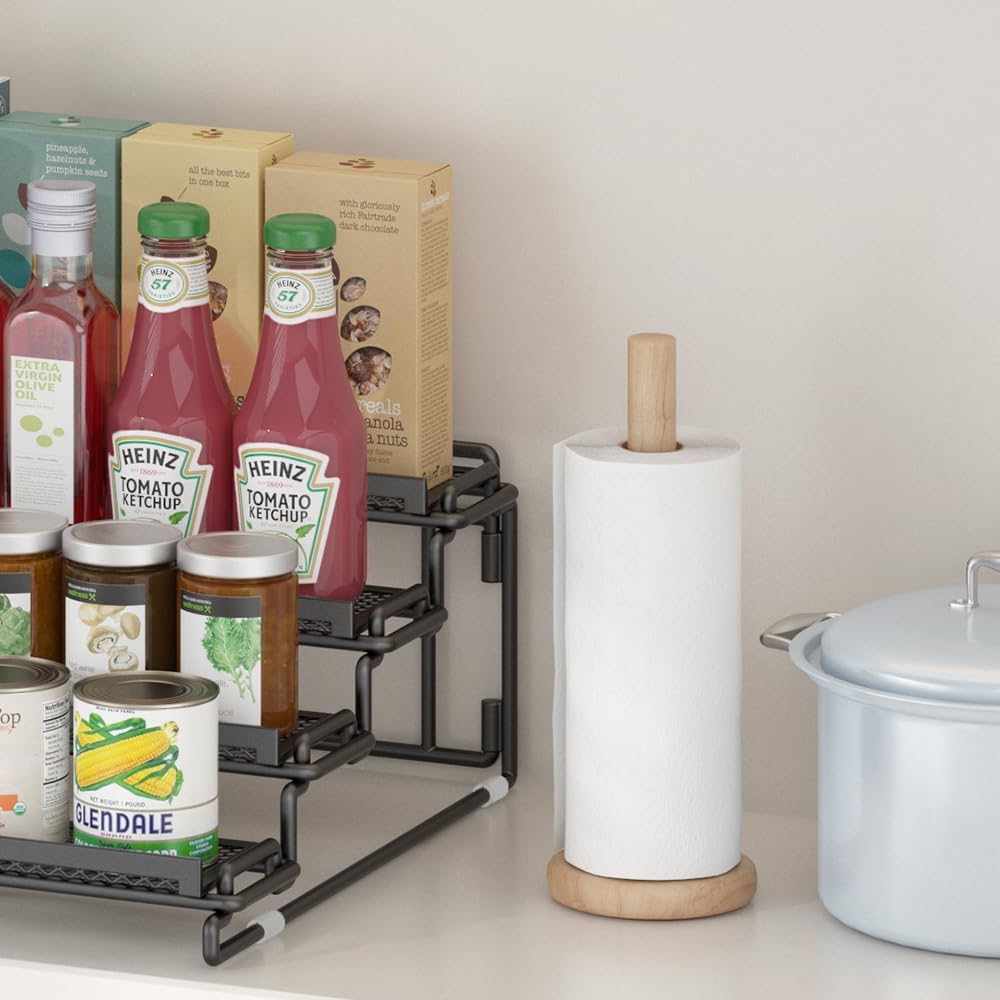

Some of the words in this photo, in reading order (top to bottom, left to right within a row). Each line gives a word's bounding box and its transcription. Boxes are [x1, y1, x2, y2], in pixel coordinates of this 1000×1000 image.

[45, 143, 89, 156] pineapple,
[45, 154, 87, 165] hazelnuts
[88, 158, 96, 166] &
[45, 164, 83, 177] pumpkin
[85, 168, 108, 178] seeds
[188, 166, 199, 175] all
[201, 167, 214, 176] the
[216, 168, 233, 177] best
[235, 170, 250, 179] bits
[188, 177, 197, 185] in
[215, 178, 230, 188] box
[339, 199, 358, 208] with
[360, 200, 400, 212] gloriously
[339, 210, 356, 219] rich
[339, 221, 358, 231] dark
[360, 222, 399, 234] chocolate
[150, 268, 174, 278] HEINZ
[151, 278, 172, 290] 57
[276, 280, 301, 290] HEINZ
[277, 290, 298, 302] 57
[15, 359, 60, 372] EXTRA
[15, 370, 62, 383] VIRGIN
[15, 380, 56, 392] OLIVE
[15, 390, 37, 401] OIL
[357, 399, 401, 416] reals
[365, 417, 404, 431] anola
[377, 433, 408, 447] nuts
[122, 447, 180, 470] HEINZ
[248, 460, 306, 482] HEINZ
[120, 475, 184, 497] TOMATO
[122, 492, 181, 510] KETCHUP
[246, 488, 311, 510] TOMATO
[249, 505, 308, 523] KETCHUP
[100, 798, 119, 806] WEIGHT
